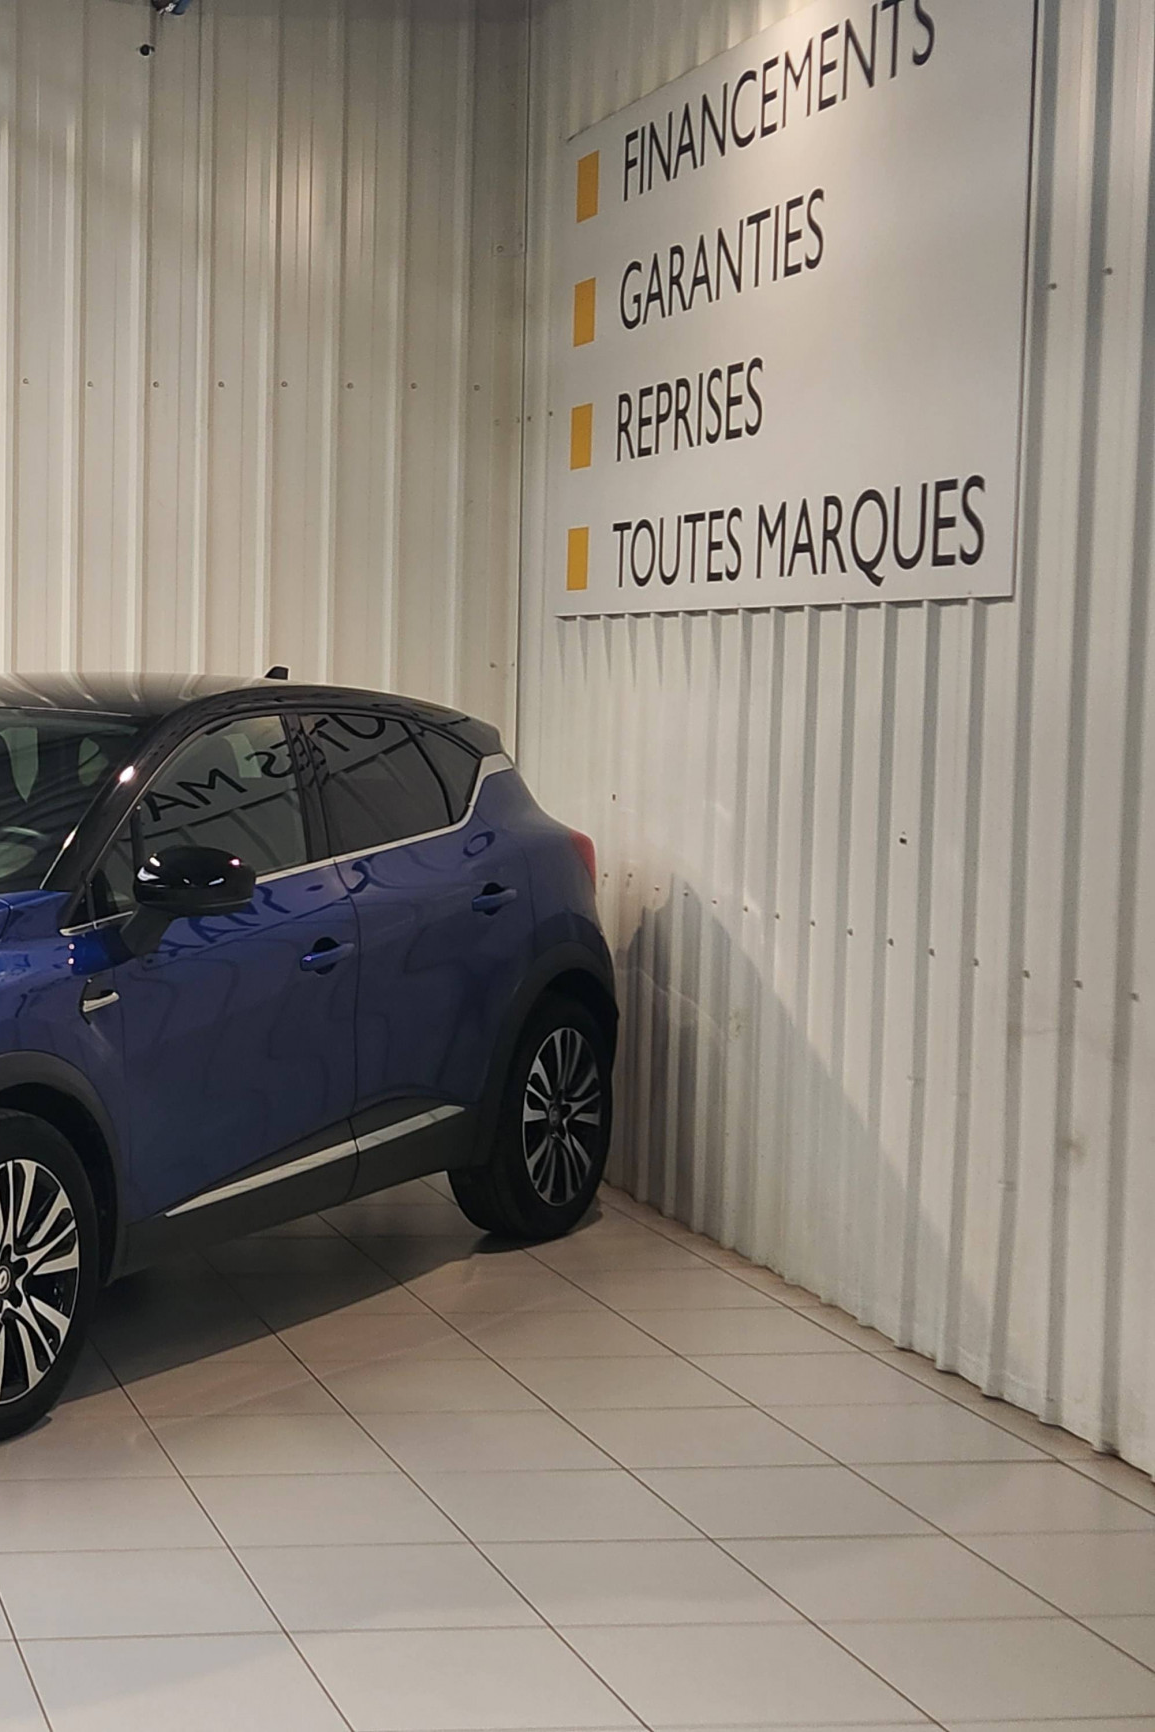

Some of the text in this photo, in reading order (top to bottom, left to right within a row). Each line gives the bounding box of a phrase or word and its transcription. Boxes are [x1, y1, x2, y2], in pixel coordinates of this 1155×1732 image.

[623, 0, 935, 202] FINANCEMENTS
[620, 188, 825, 330] GARANTIES
[616, 357, 764, 463] REPRISES
[612, 474, 986, 588] TOUTES MARQUES
